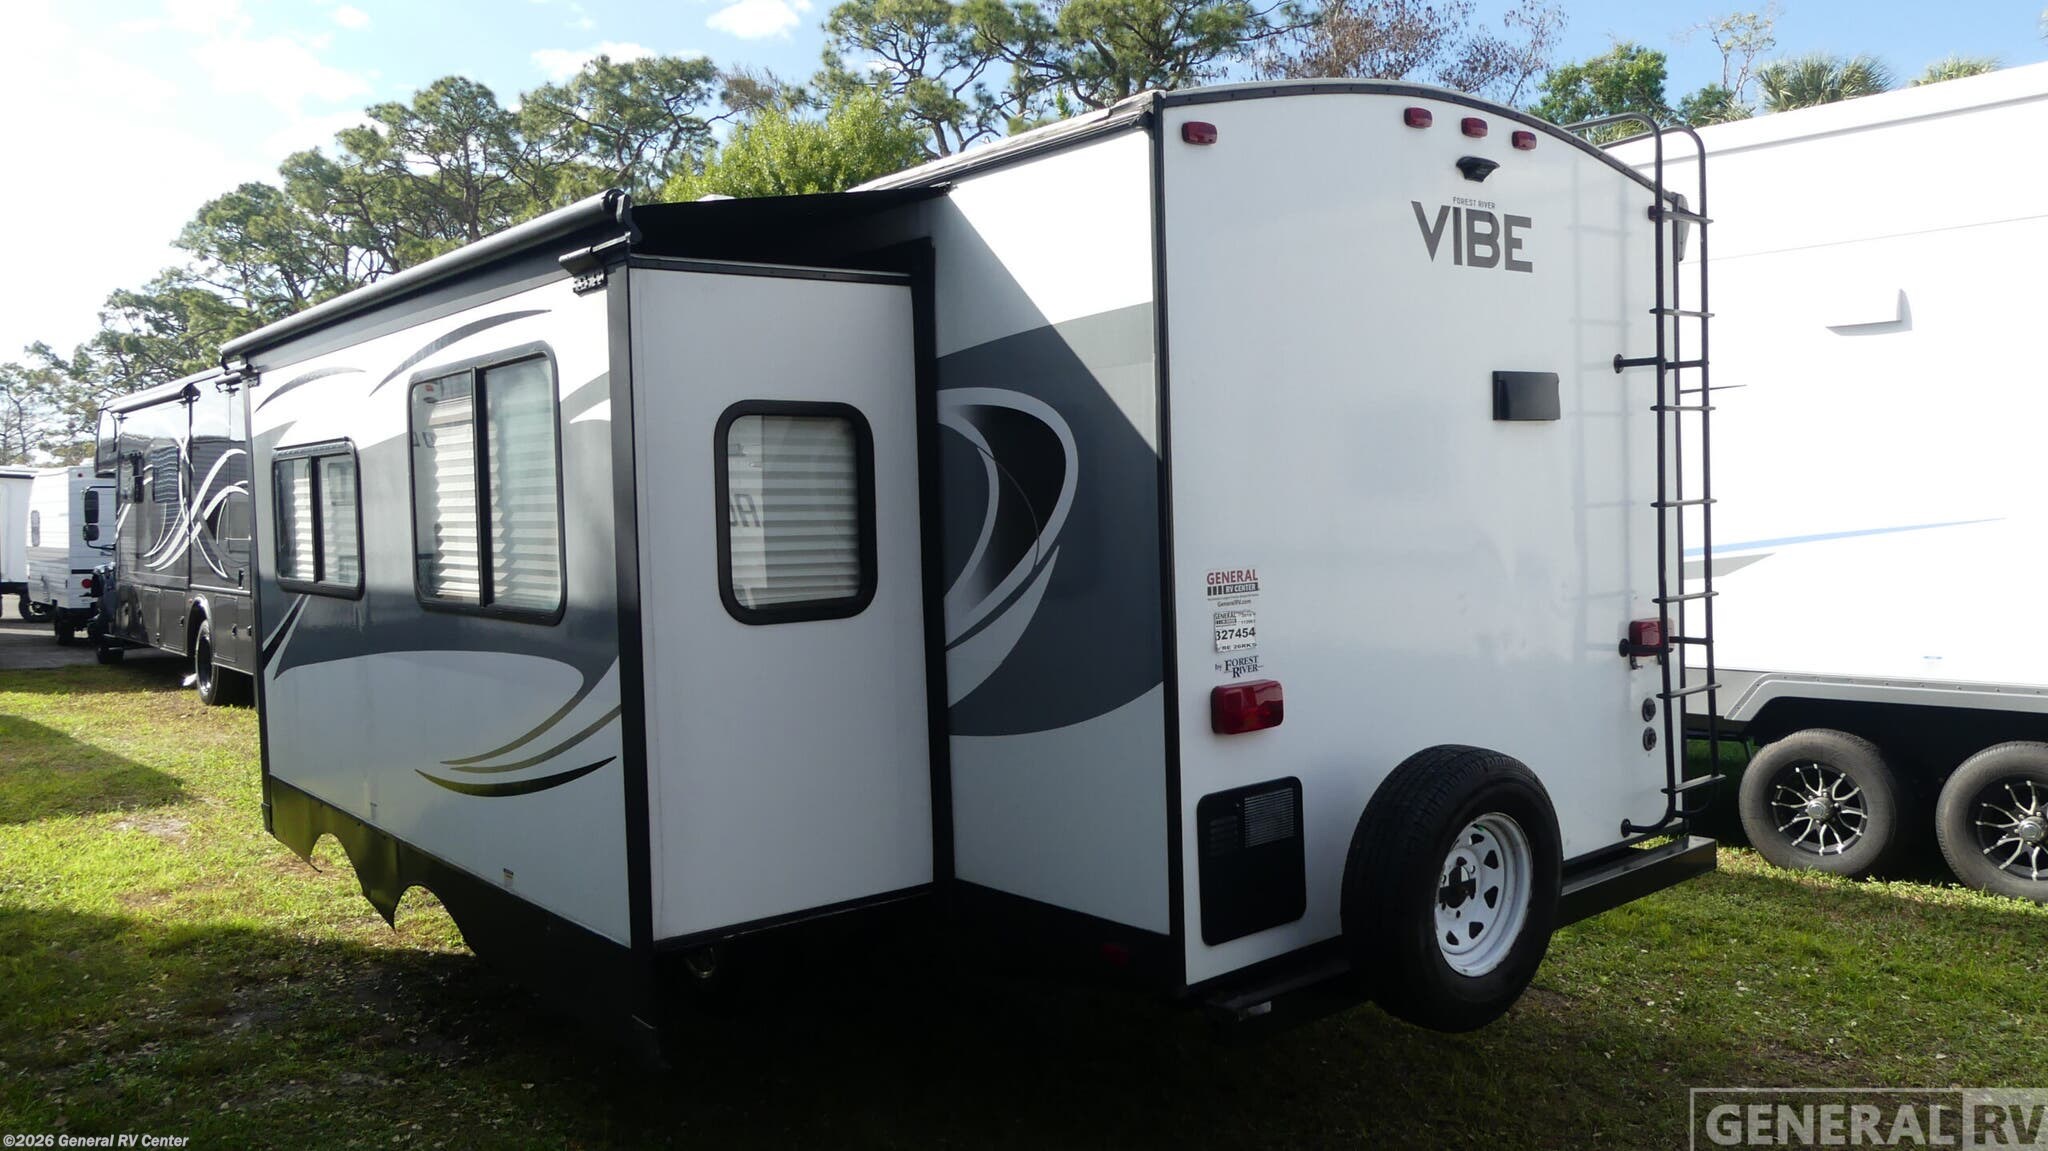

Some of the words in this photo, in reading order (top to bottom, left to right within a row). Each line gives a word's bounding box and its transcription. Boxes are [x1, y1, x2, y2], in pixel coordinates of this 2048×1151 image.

[1452, 196, 1477, 207] FOREST
[1478, 200, 1496, 209] RIVER
[1410, 200, 1533, 273] VIBE
[1206, 569, 1258, 585] GENERAL
[1225, 585, 1234, 593] RV
[1234, 583, 1256, 592] CENTER
[1225, 656, 1259, 671] FOREST
[1232, 664, 1259, 678] RIVER
